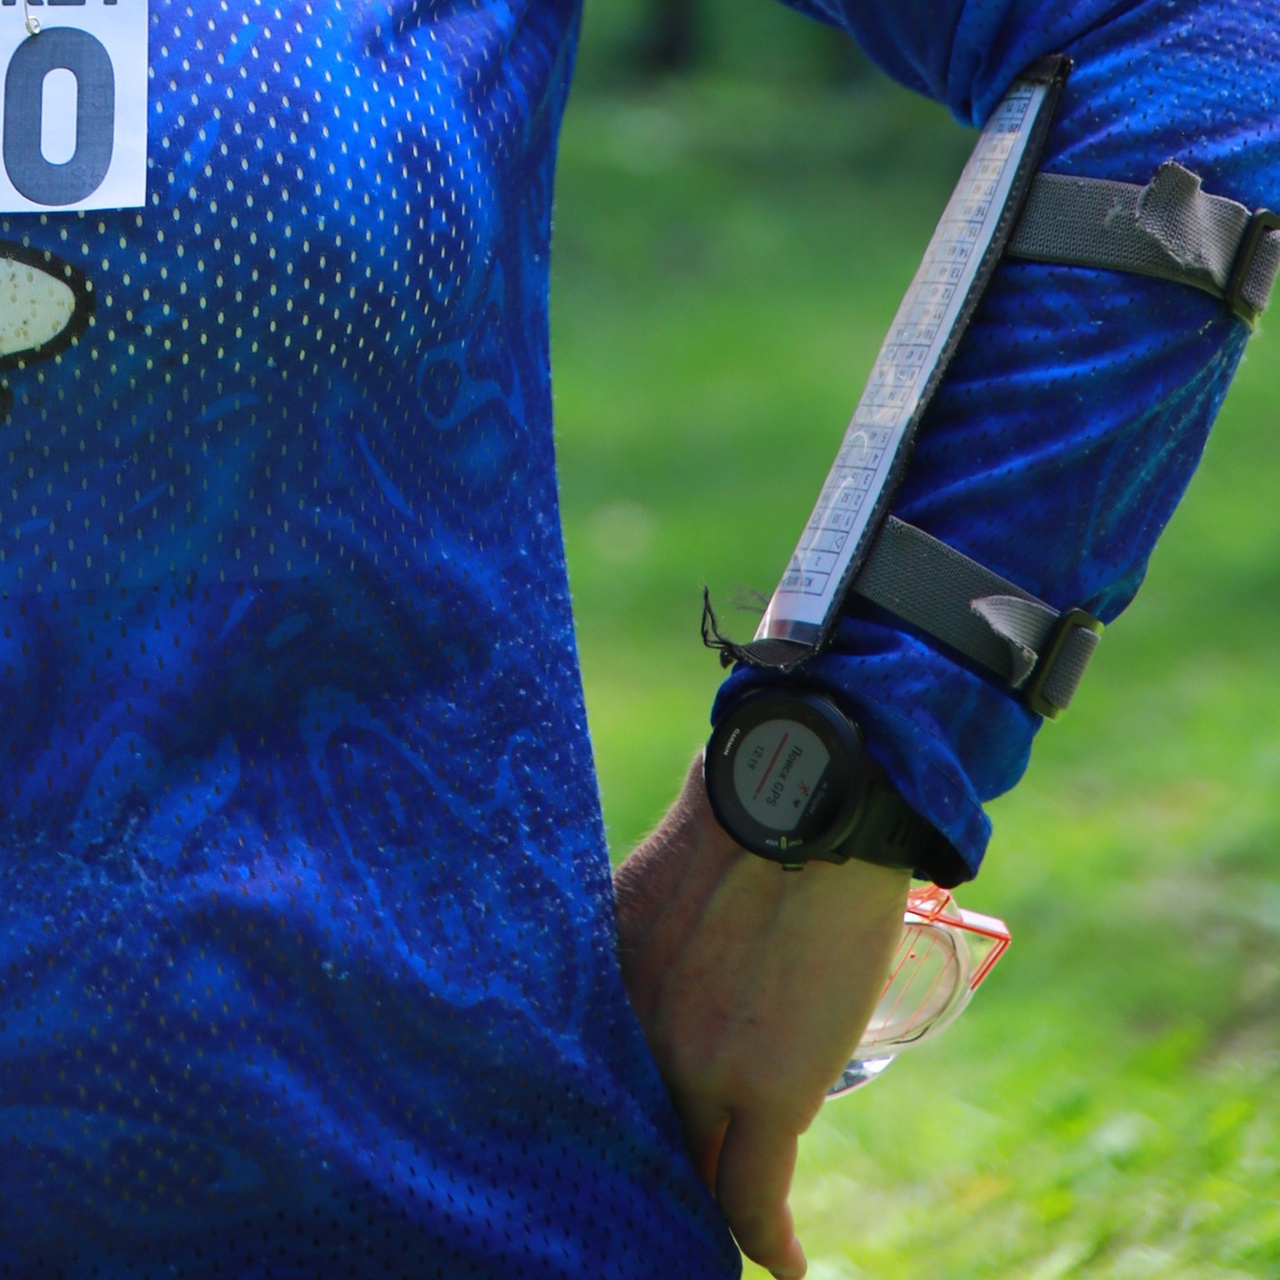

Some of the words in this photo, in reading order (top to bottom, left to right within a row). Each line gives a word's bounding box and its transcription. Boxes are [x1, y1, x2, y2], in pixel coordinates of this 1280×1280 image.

[747, 745, 764, 770] 12:19
[778, 745, 803, 781] Поиск
[766, 781, 785, 807] GPS
